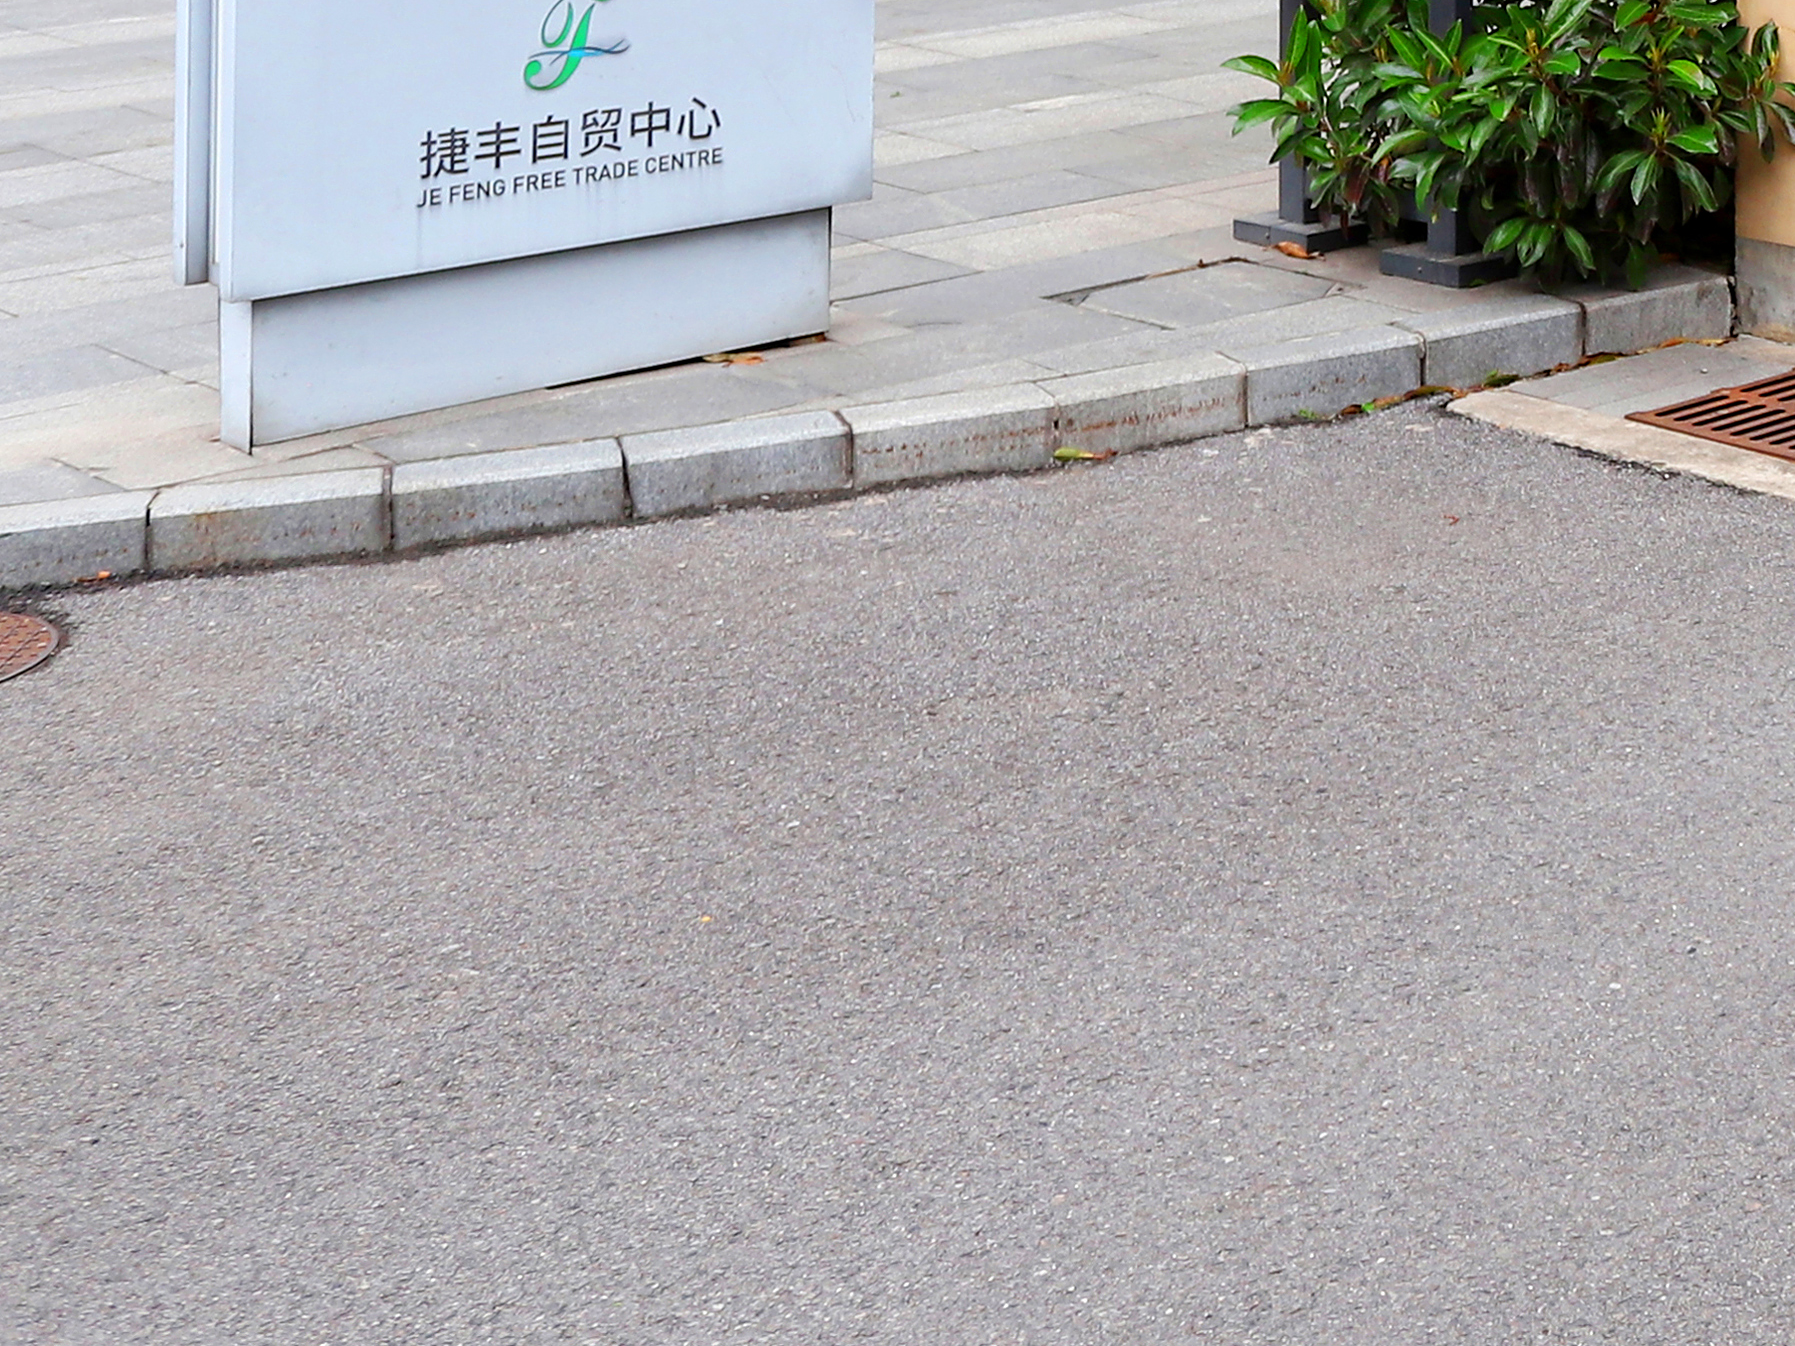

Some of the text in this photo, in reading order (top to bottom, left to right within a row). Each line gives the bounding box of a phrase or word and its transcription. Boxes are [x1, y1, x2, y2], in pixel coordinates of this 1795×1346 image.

[419, 96, 723, 181] 捷丰自贸中心
[416, 146, 724, 209] JE FENG FREE TRADE CENTRE
